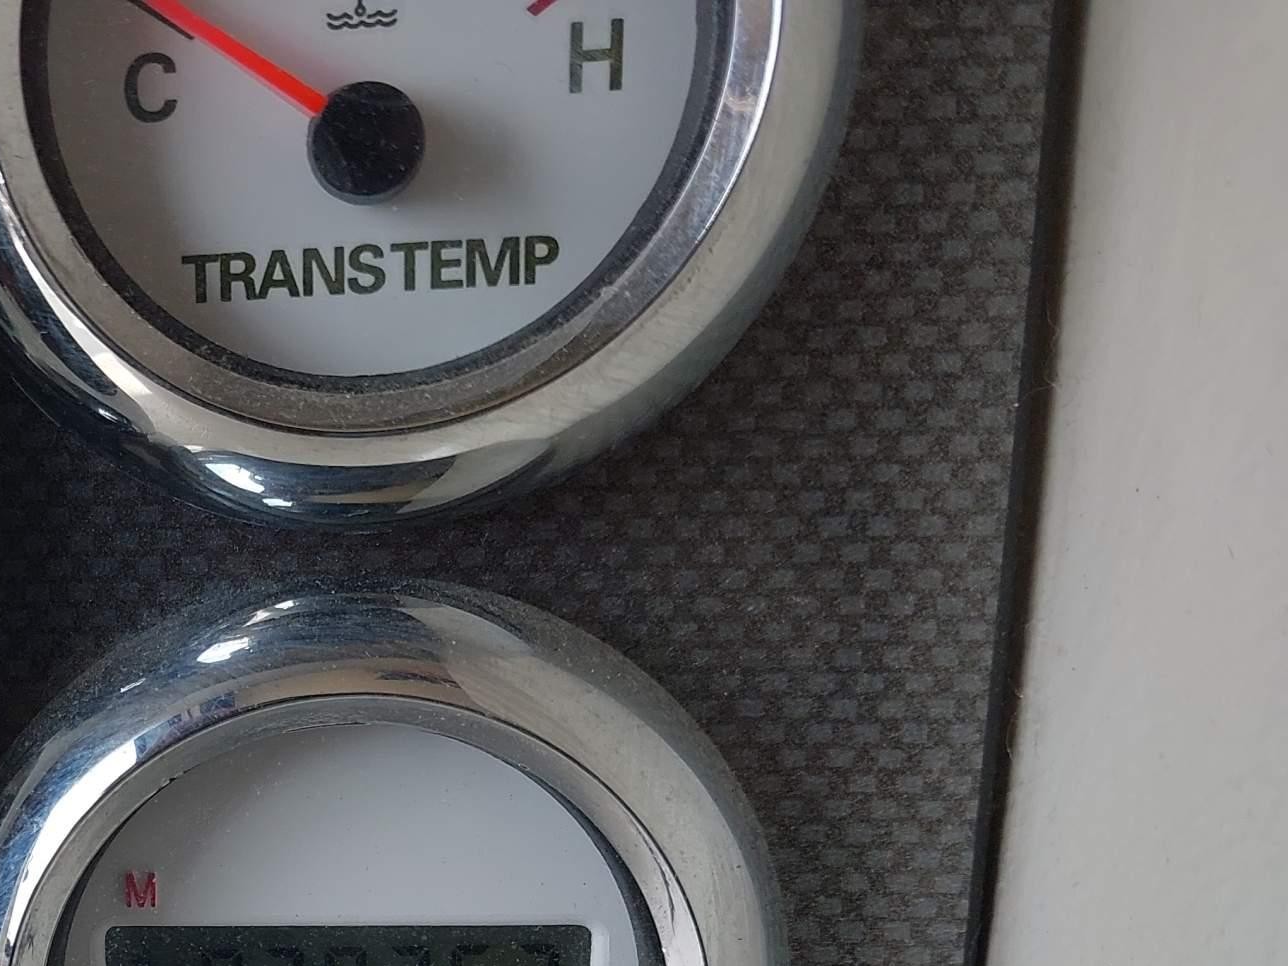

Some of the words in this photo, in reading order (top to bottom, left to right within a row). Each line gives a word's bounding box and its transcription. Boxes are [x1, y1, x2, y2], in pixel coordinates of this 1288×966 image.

[123, 52, 178, 123] C
[569, 18, 624, 94] H
[124, 872, 158, 908] M
